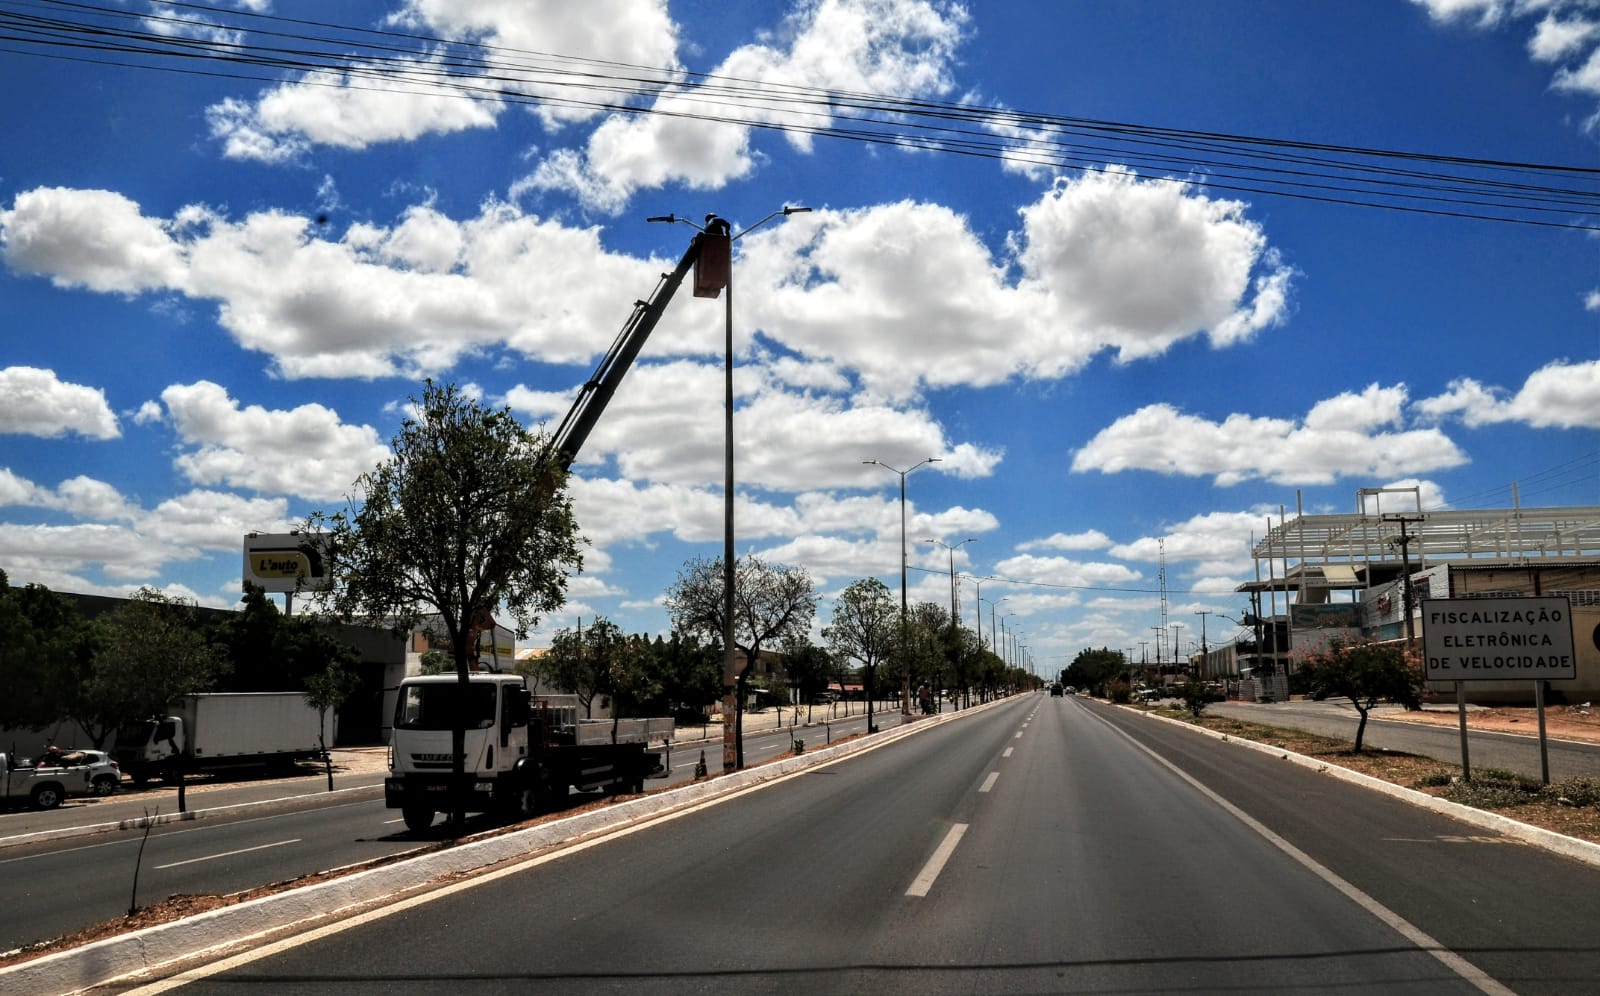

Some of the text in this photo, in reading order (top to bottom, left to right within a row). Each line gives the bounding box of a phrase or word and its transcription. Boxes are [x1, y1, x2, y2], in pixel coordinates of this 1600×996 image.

[260, 559, 298, 571] L'auto
[1431, 607, 1562, 625] FISCALIZAÇÃO
[1443, 631, 1552, 648] ELETRÔNICA
[1429, 655, 1571, 669] DE VELOCIDADE
